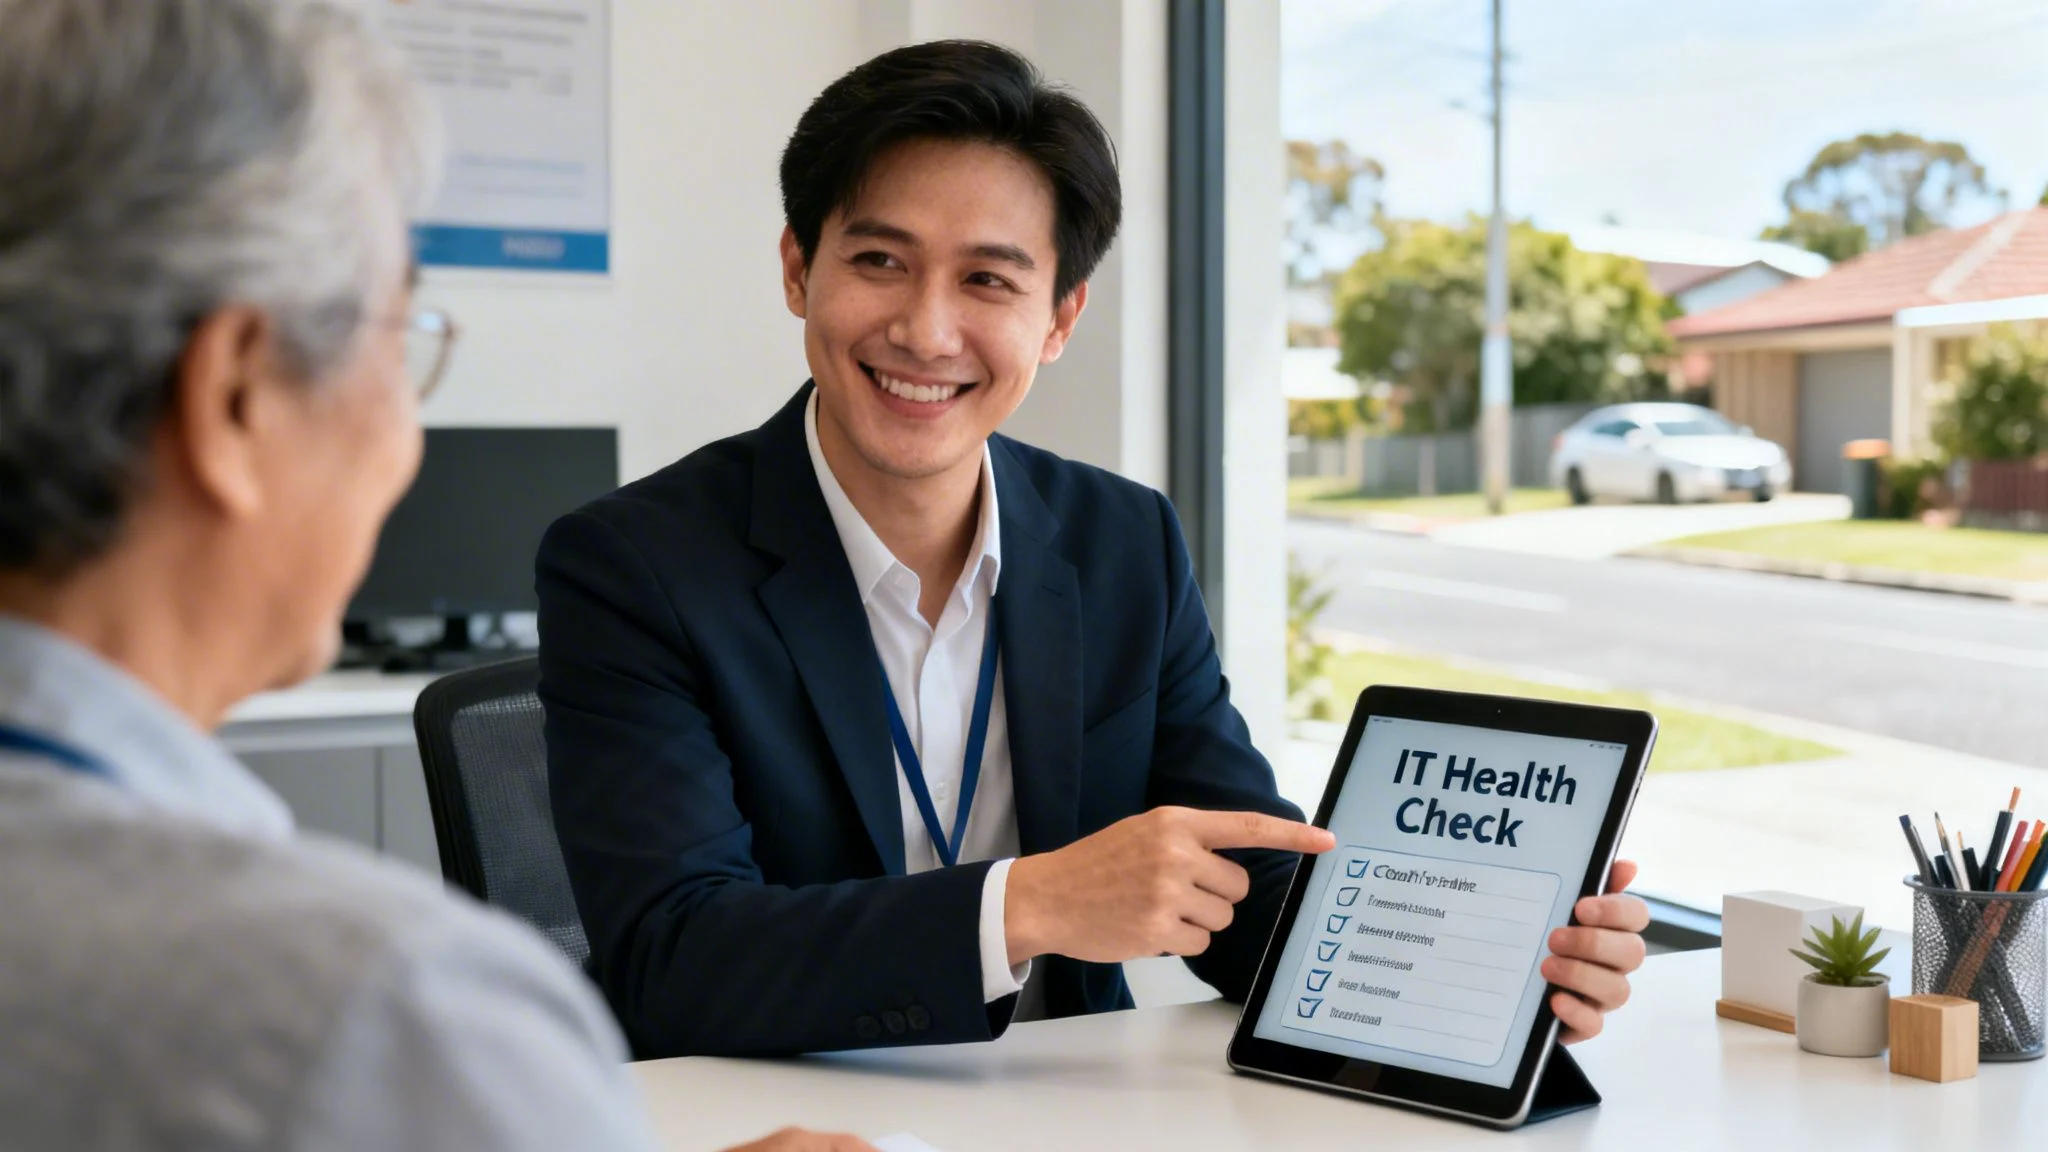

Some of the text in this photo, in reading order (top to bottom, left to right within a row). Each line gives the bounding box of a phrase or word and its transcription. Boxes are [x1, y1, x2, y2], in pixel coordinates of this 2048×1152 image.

[1392, 748, 1578, 806] IT Health
[1394, 796, 1524, 848] Check
